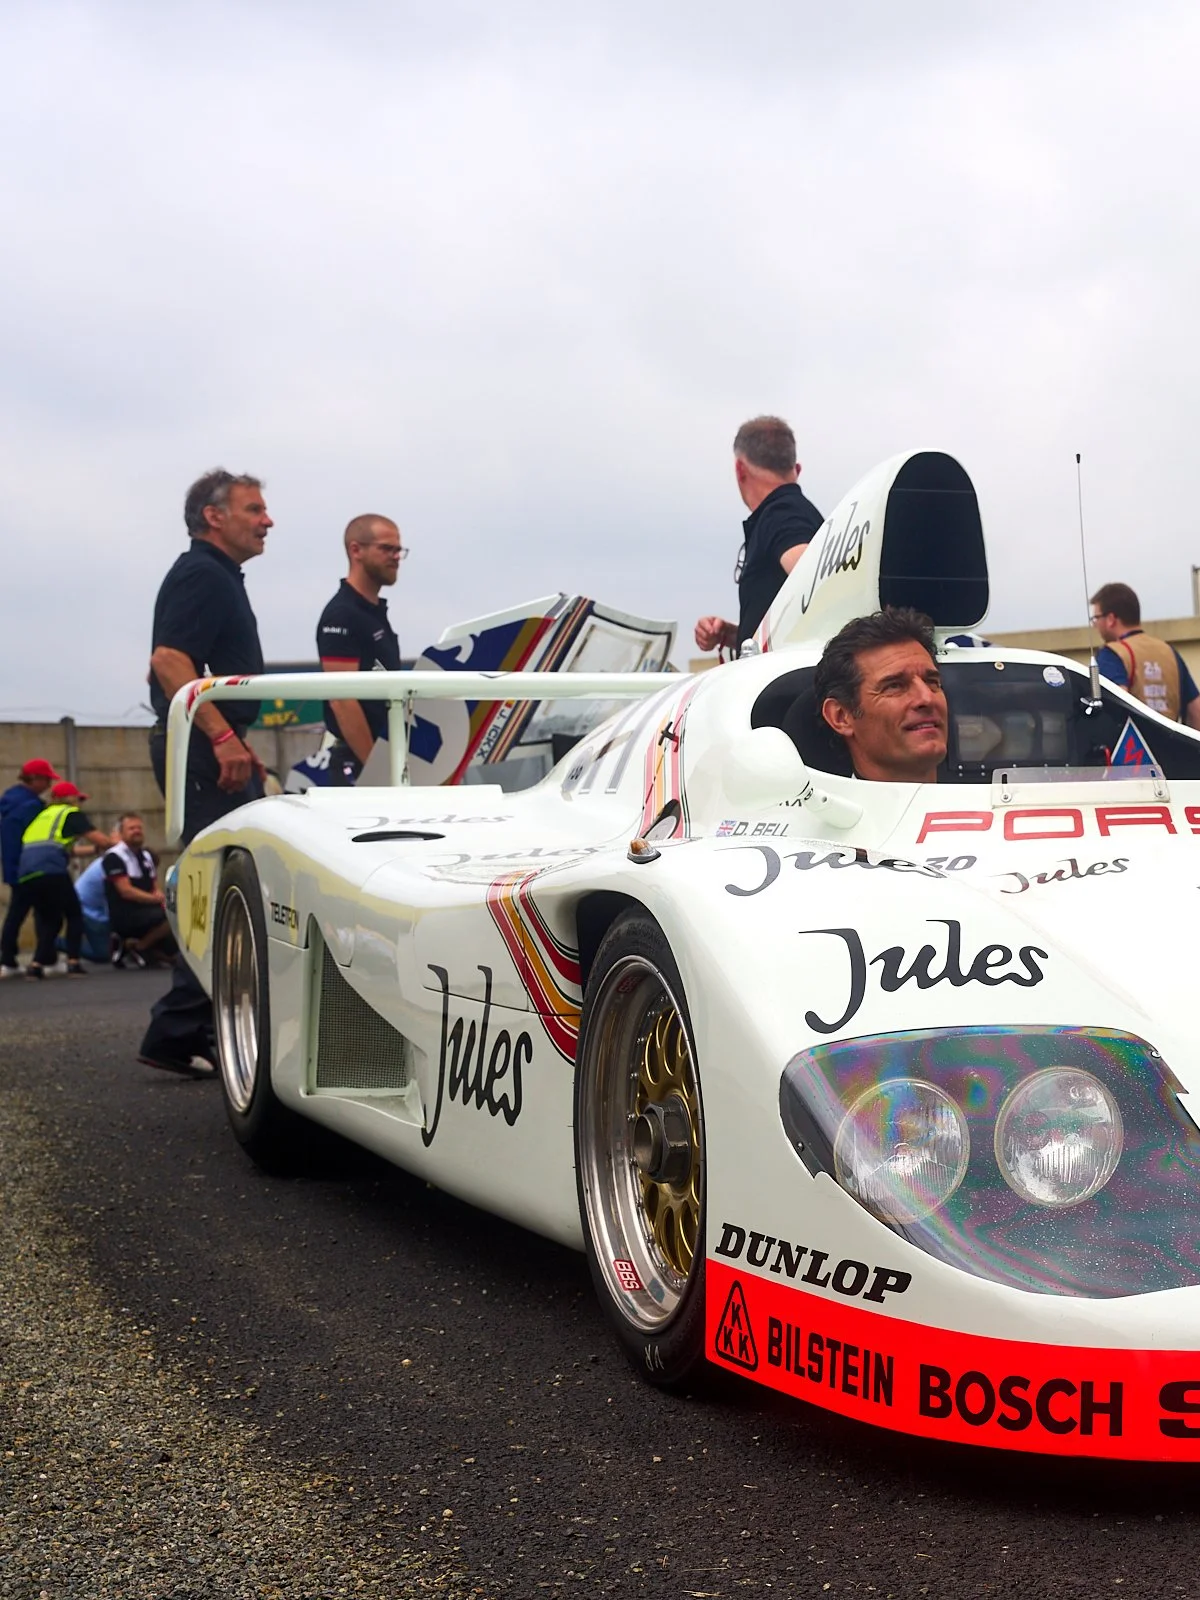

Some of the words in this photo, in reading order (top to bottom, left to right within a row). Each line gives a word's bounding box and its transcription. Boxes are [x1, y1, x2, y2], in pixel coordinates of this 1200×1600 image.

[801, 501, 870, 614] Jules
[477, 724, 499, 758] ICKX
[732, 822, 748, 836] D.
[751, 822, 791, 838] BELL
[713, 845, 948, 897] Jules
[988, 857, 1129, 894] Jules
[798, 919, 1049, 1034] Jules
[421, 963, 533, 1148] Jules
[617, 1260, 640, 1290] BBS
[715, 1222, 912, 1303] DUNLOP
[768, 1316, 894, 1407] BILSTEIN
[919, 1363, 1124, 1437] BOSCH
